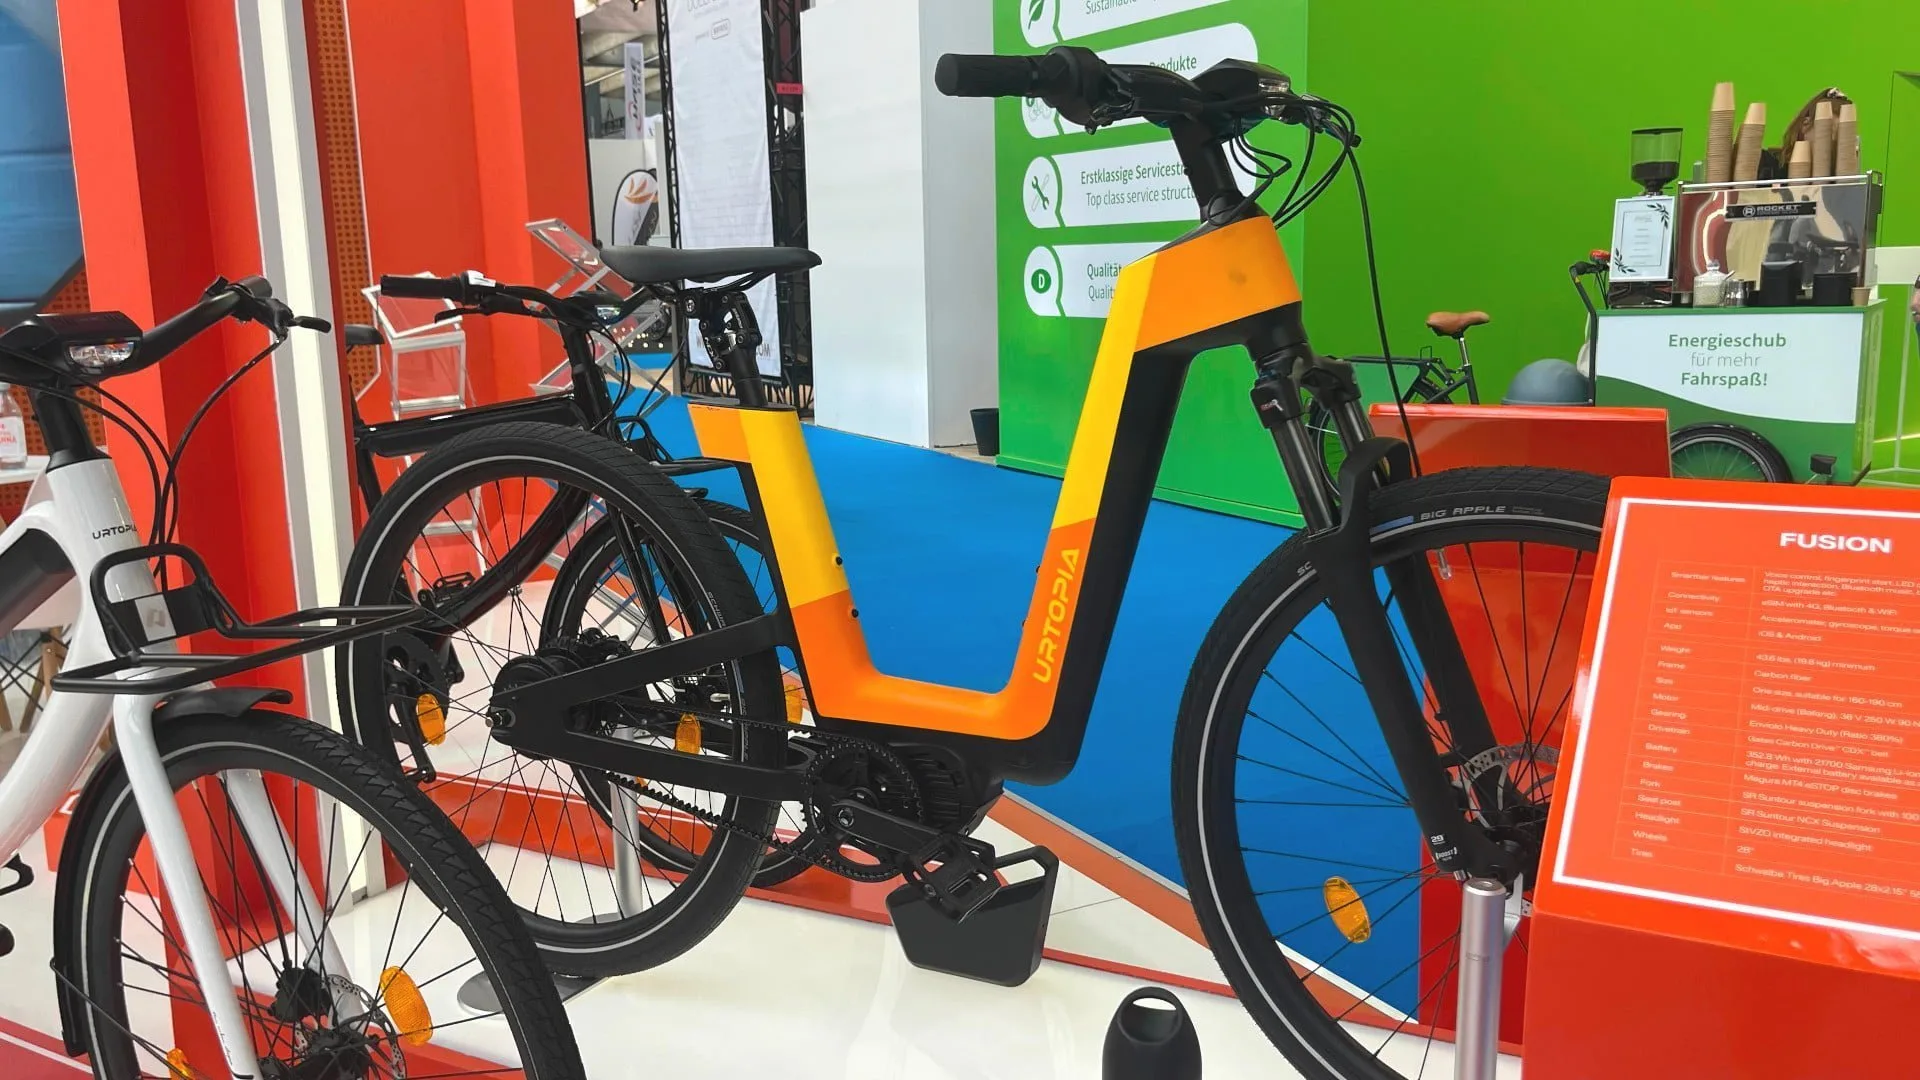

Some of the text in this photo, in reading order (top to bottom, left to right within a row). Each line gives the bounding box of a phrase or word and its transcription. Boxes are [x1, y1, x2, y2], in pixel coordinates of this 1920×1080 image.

[1081, 165, 1134, 185] Erstklassige
[1086, 192, 1102, 210] Top
[1103, 189, 1125, 206] class
[1126, 187, 1159, 204] service
[1756, 204, 1800, 212] ROCKET
[1668, 333, 1787, 351] Energieschub
[1691, 352, 1762, 367] für mehr
[1681, 371, 1768, 389] Fahrspaß!
[1420, 508, 1447, 520] BIG
[1452, 504, 1507, 516] APPLE
[1779, 532, 1892, 553] FUSION
[1032, 547, 1080, 684] URTOPIA
[1754, 669, 1789, 680] Carbon
[1784, 723, 1815, 735] Heavy
[1815, 727, 1839, 737] Duty
[1775, 738, 1810, 749] Carbon
[1822, 768, 1858, 780] battery
[1798, 799, 1854, 814] suspension
[1855, 804, 1877, 815] fork
[1878, 808, 1900, 818] with
[1772, 831, 1824, 845] integrated
[1812, 874, 1830, 886] Big
[1830, 878, 1862, 890] Apple
